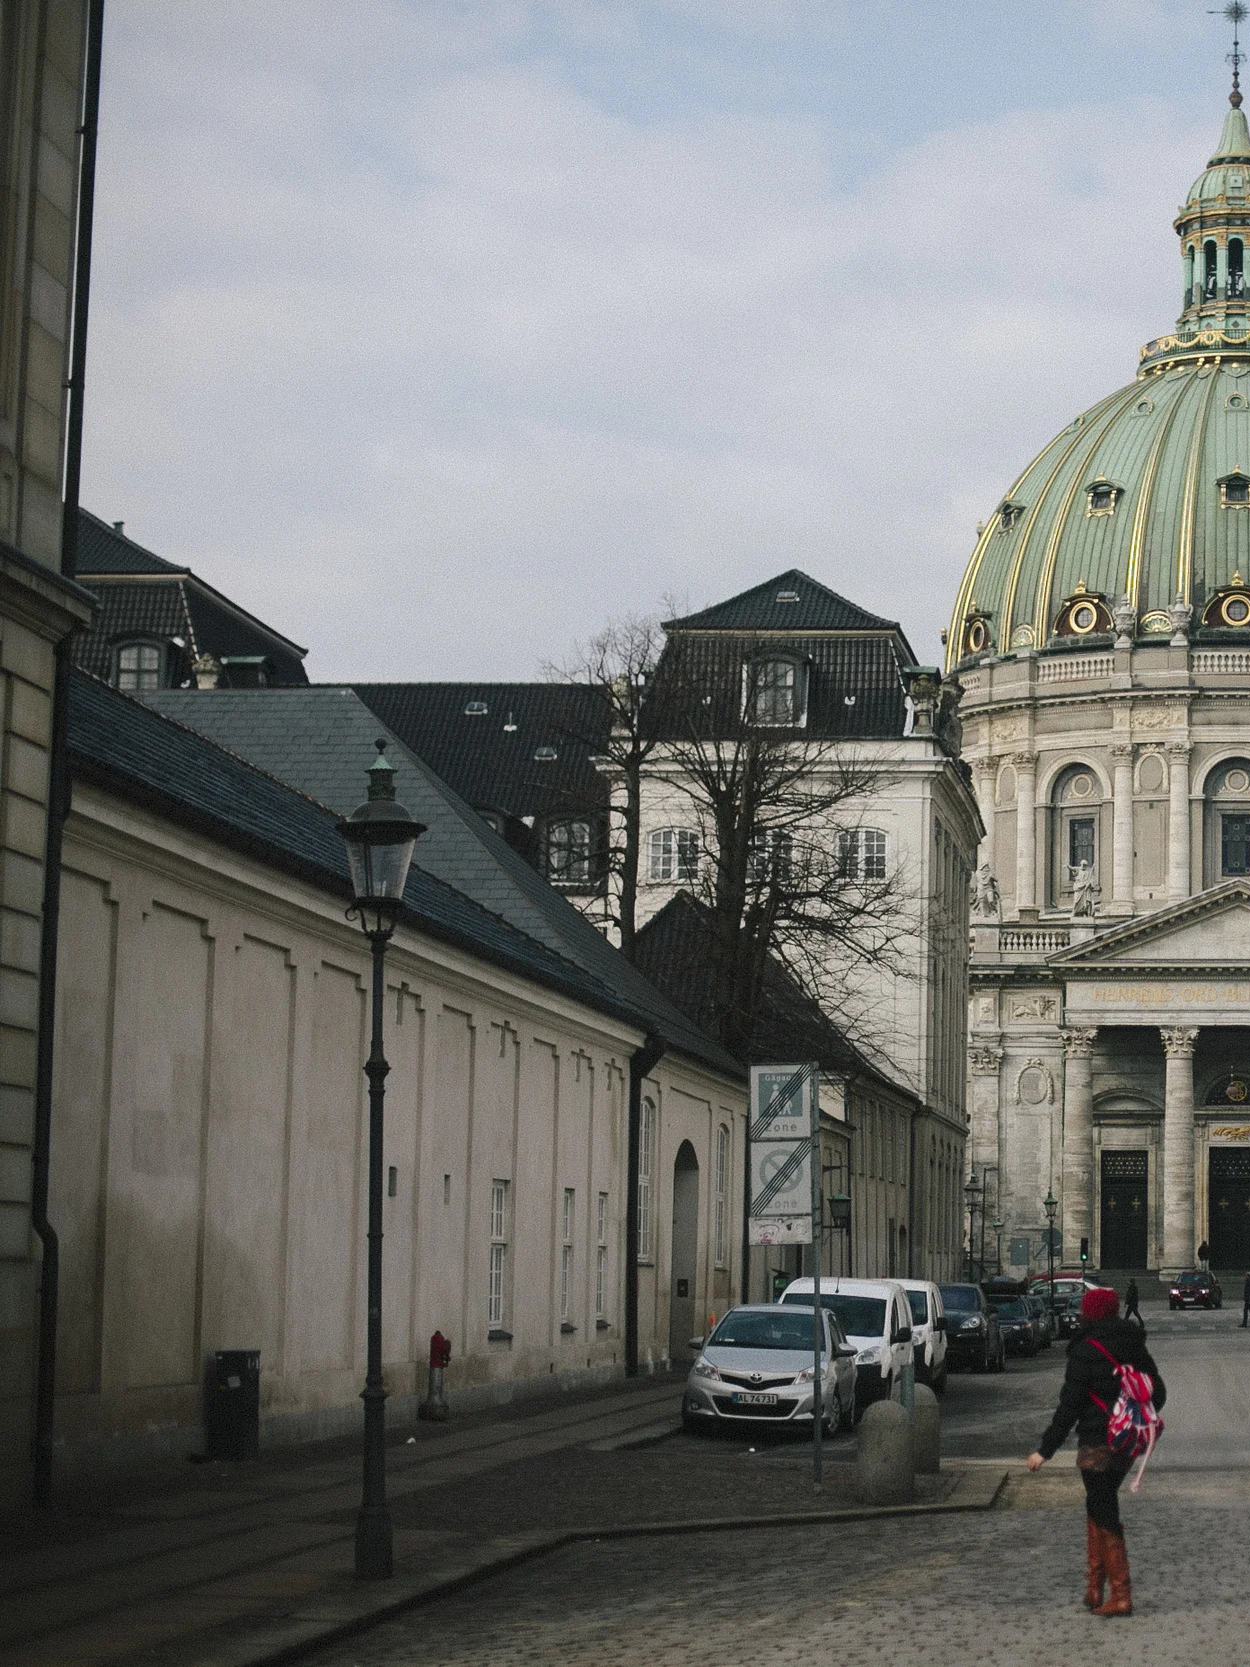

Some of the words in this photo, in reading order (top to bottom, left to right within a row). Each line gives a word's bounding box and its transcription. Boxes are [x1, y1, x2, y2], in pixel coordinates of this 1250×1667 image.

[1092, 986, 1176, 1002] HERRENS
[1181, 986, 1218, 1002] ORD
[764, 1074, 797, 1083] Gågad
